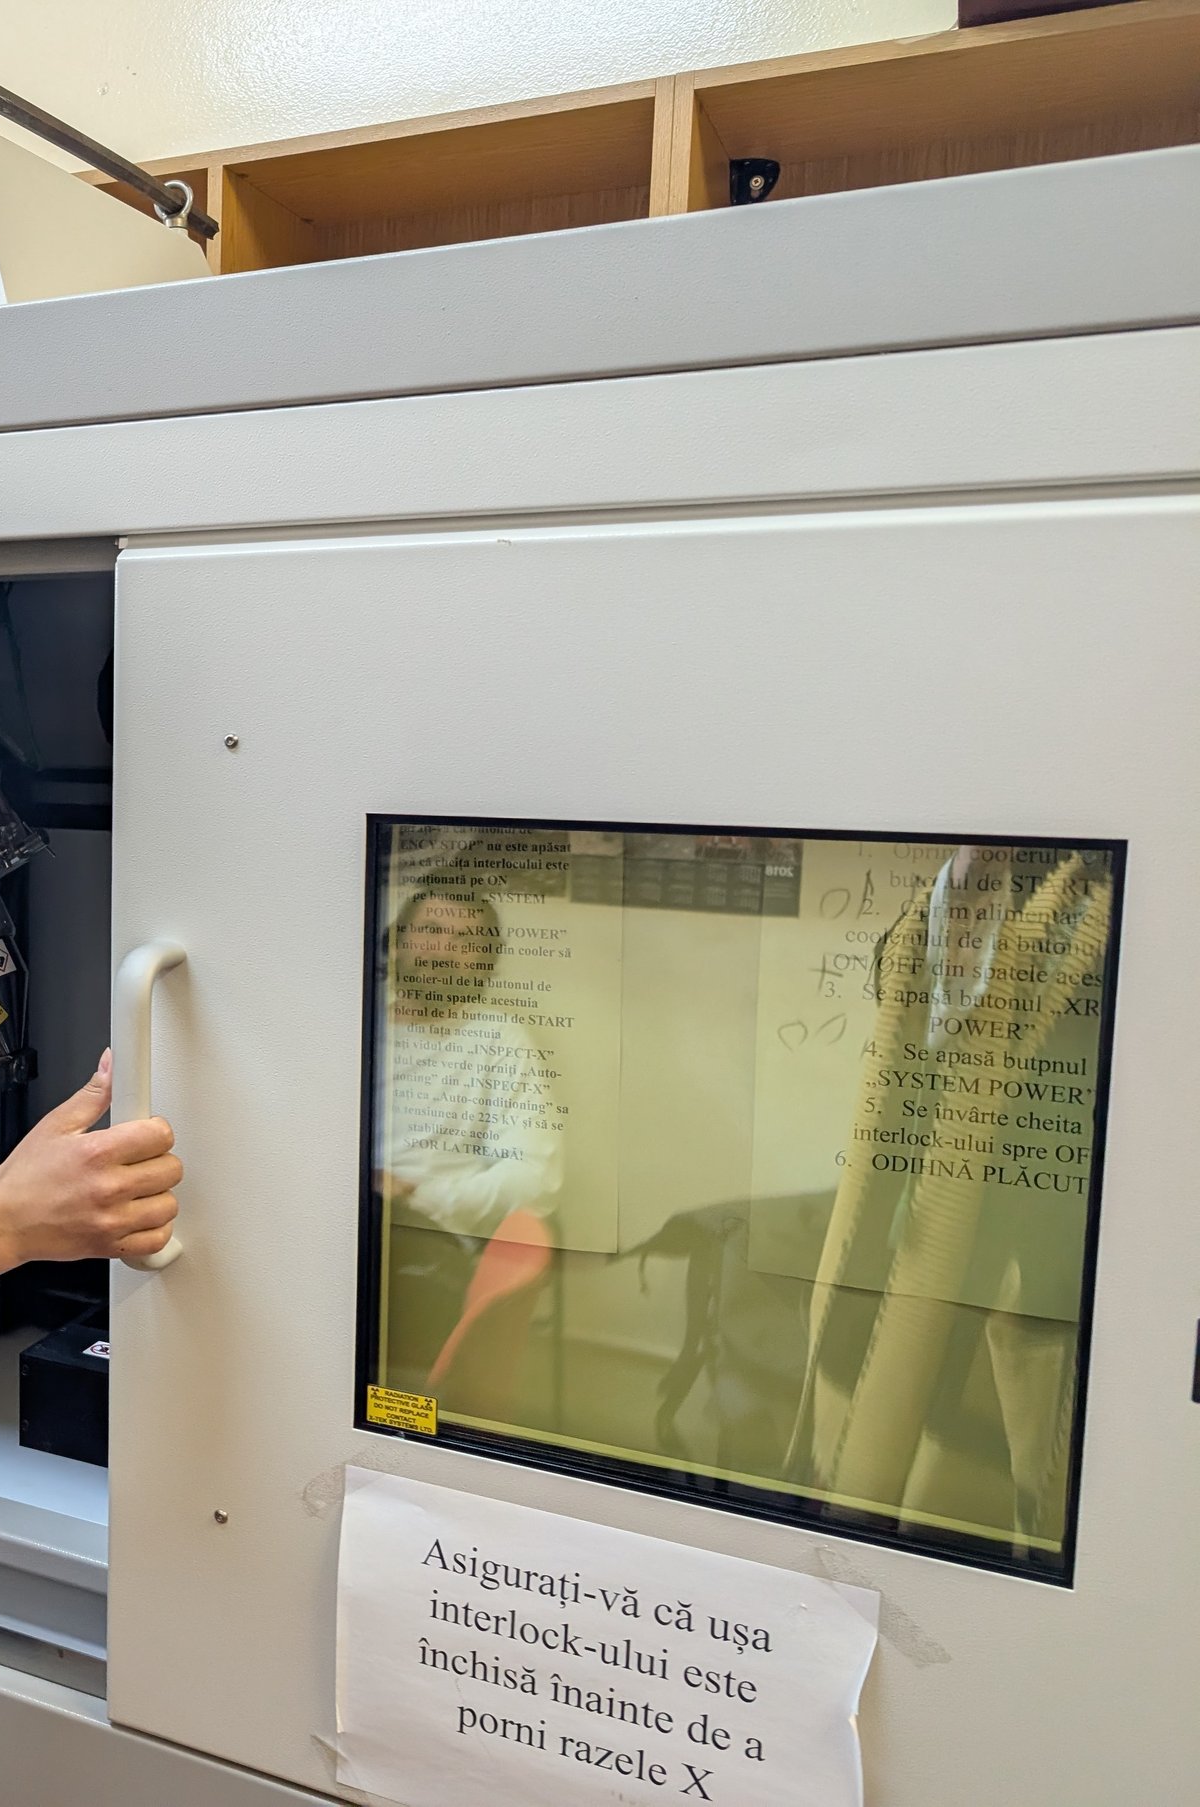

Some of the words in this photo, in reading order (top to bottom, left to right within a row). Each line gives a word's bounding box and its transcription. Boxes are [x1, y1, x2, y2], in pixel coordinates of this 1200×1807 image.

[488, 843, 502, 851] nu
[506, 844, 528, 852] este
[531, 842, 571, 854] apăsat
[473, 858, 542, 870] interlocului
[546, 862, 569, 870] este
[470, 877, 484, 887] pe
[487, 875, 507, 885] ON
[977, 874, 1002, 892] de
[412, 892, 426, 902] pe
[430, 890, 475, 902] butonul
[861, 898, 880, 915] 2.
[410, 924, 454, 935] butonul
[958, 931, 983, 949] de
[992, 932, 1009, 950] la
[444, 942, 457, 952] de
[461, 942, 492, 954] glicol
[496, 944, 514, 955] din
[518, 945, 554, 957] cooler
[558, 948, 572, 958] să
[431, 959, 460, 970] peste
[464, 961, 494, 971] semn
[931, 959, 965, 977] din
[972, 965, 1049, 985] spatele
[457, 976, 470, 987] de
[474, 977, 484, 987] la
[488, 978, 534, 990] butonul
[537, 981, 552, 991] de
[425, 991, 443, 1002] din
[447, 991, 487, 1006] spatele
[490, 995, 538, 1008] acestuia
[825, 981, 843, 998] 3.
[862, 984, 886, 1001] Se
[894, 988, 952, 1008] apasă
[960, 990, 1042, 1012] butonul
[431, 1008, 445, 1018] de
[448, 1009, 458, 1019] la
[462, 1010, 507, 1023] butonul
[511, 1012, 525, 1024] de
[528, 1015, 575, 1028] START
[407, 1023, 425, 1033] din
[454, 1026, 501, 1040] acestuia
[413, 1040, 442, 1050] vidul
[445, 1042, 463, 1053] din
[864, 1040, 884, 1058] 4.
[903, 1043, 929, 1061] Se
[936, 1049, 995, 1068] apasă
[416, 1058, 437, 1067] este
[441, 1059, 473, 1071] verde
[477, 1062, 517, 1077] porniți
[441, 1074, 459, 1086] din
[556, 1106, 569, 1114] sa
[864, 1096, 883, 1115] 5.
[902, 1100, 928, 1118] Se
[935, 1102, 1009, 1127] învârte
[1016, 1111, 1082, 1135] cheita
[461, 1110, 474, 1121] de
[478, 1112, 498, 1123] 225
[502, 1115, 521, 1126] kV
[522, 1117, 532, 1129] și
[535, 1119, 548, 1129] să
[551, 1122, 564, 1131] se
[470, 1130, 500, 1141] acolo
[852, 1123, 994, 1154] interlock-ului
[1002, 1142, 1048, 1162] spre
[1055, 1144, 1090, 1165] OF
[443, 1141, 460, 1153] LA
[834, 1150, 853, 1168] 6.
[871, 1153, 975, 1181] ODIHNĂ
[982, 1165, 1090, 1195] PLĂCUT
[370, 1394, 410, 1407] PROTECTIVE
[411, 1402, 432, 1411] GLASS
[384, 1391, 419, 1402] RADIATION
[386, 1413, 416, 1423] CONTACT
[399, 1408, 429, 1419] REPLACE
[421, 1538, 641, 1621] Asigurați-vă
[653, 1600, 695, 1632] că
[707, 1615, 773, 1655] ușa
[428, 1590, 669, 1681] interlock-ului
[683, 1664, 758, 1703] este
[418, 1638, 539, 1696] închisă
[549, 1672, 674, 1735] înainte
[687, 1714, 731, 1751] de
[744, 1736, 766, 1761] a
[456, 1704, 547, 1751] porni
[558, 1735, 668, 1786] razele
[678, 1762, 715, 1802] X
